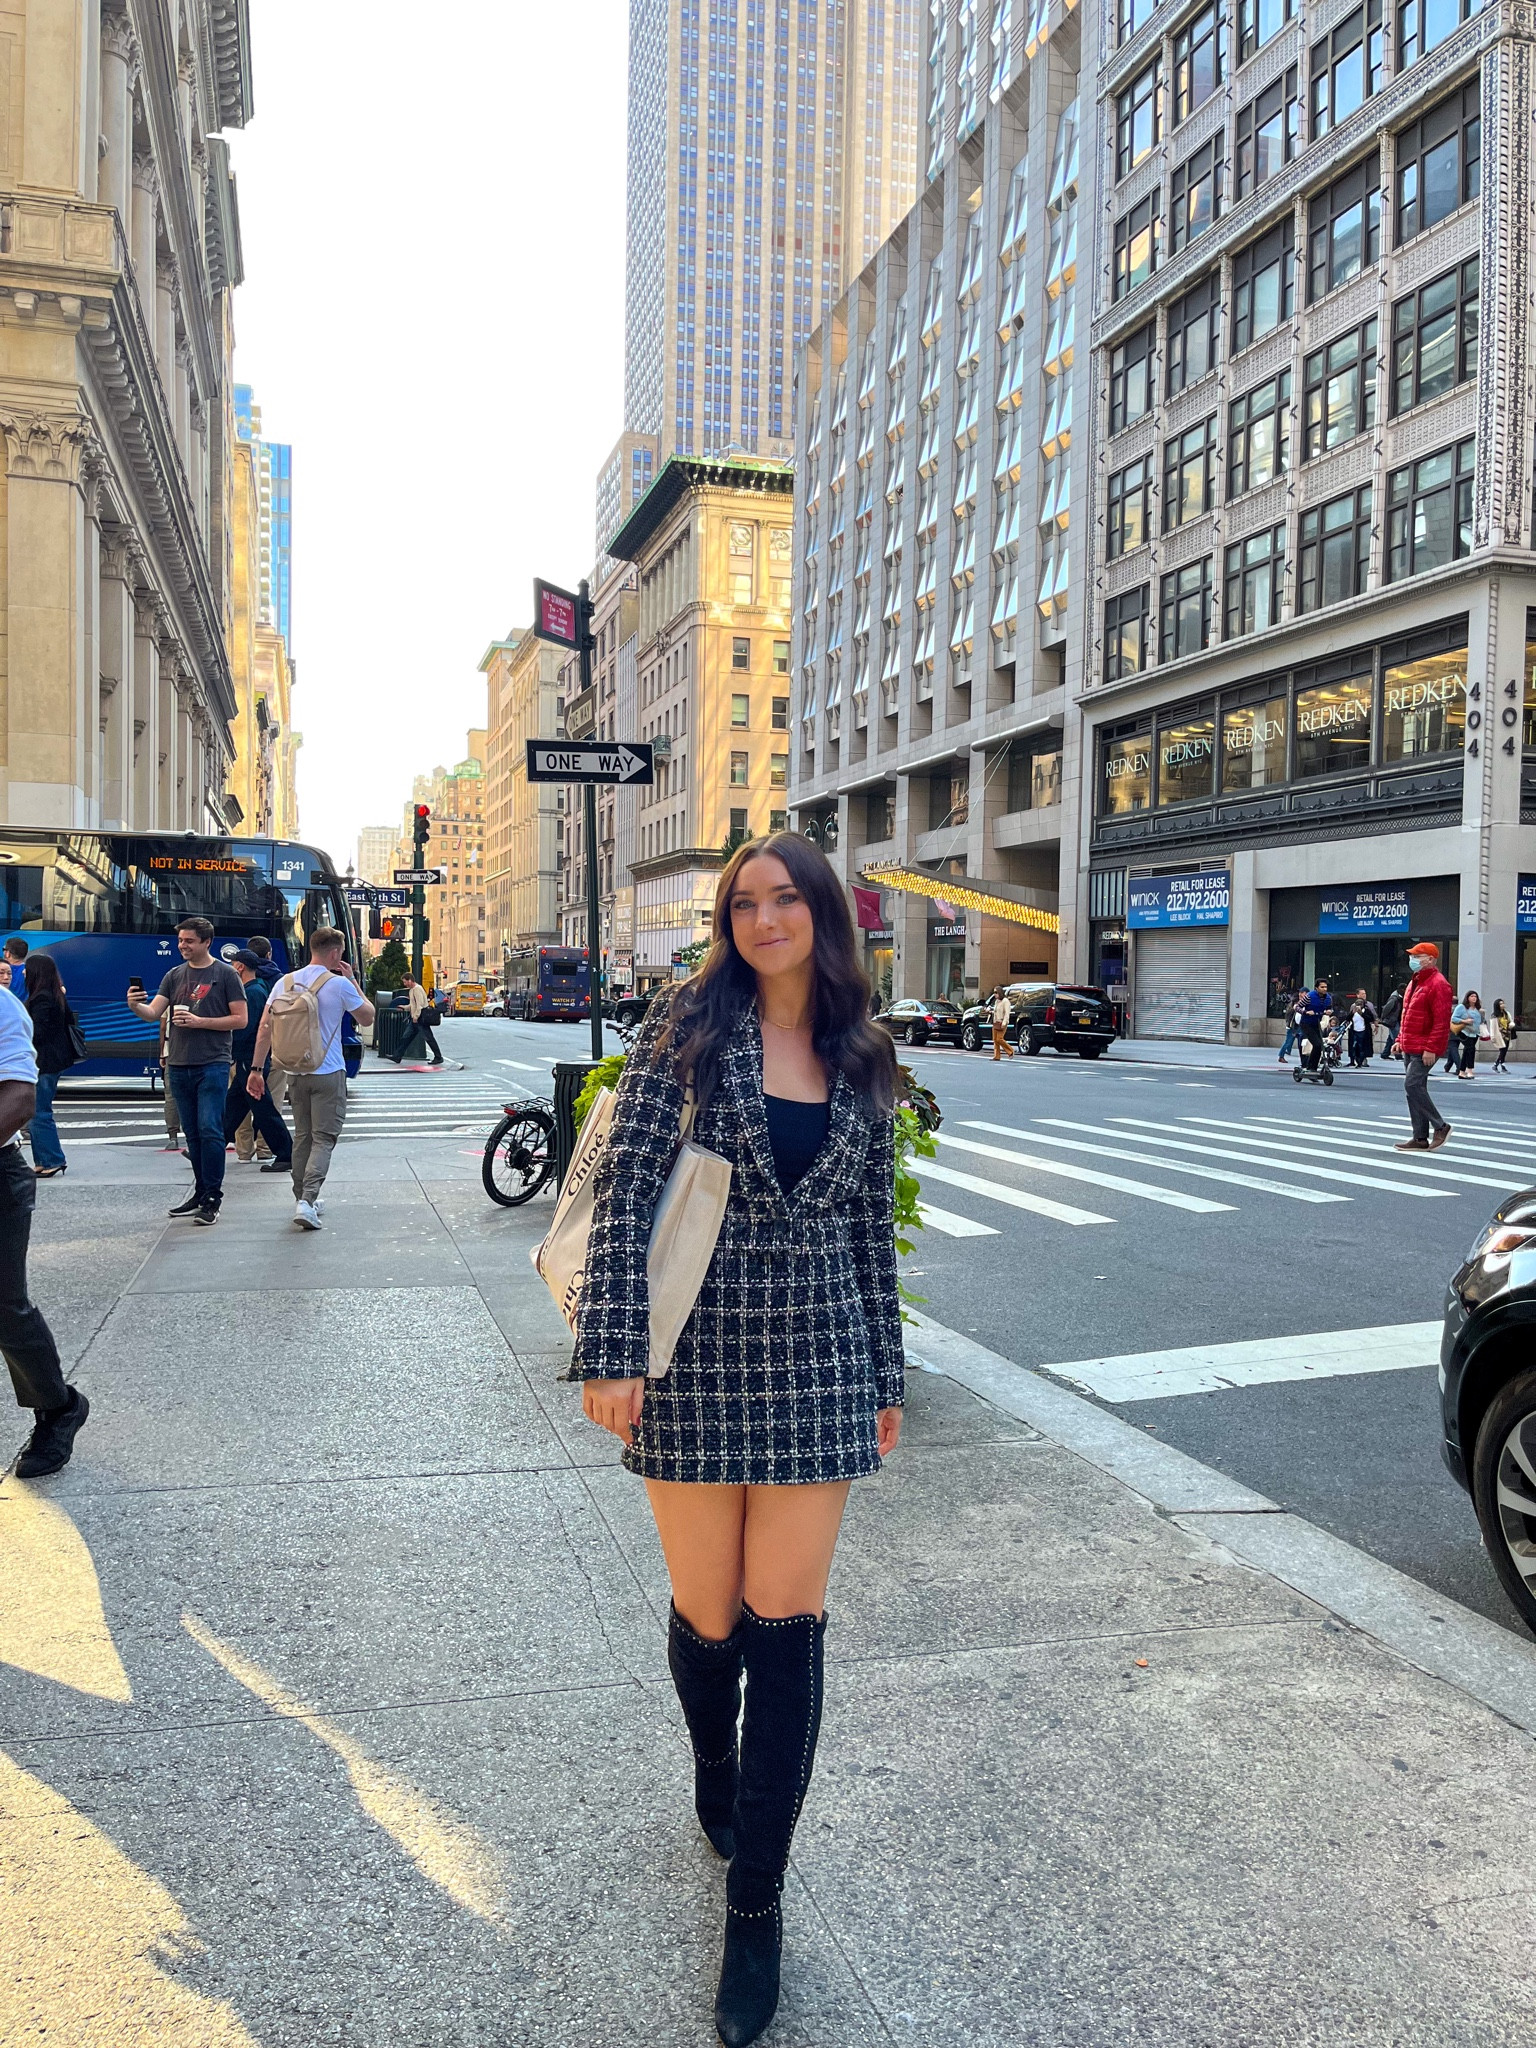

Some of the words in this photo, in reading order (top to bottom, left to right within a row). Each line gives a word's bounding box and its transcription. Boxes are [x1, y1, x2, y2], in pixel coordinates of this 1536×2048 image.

[551, 593, 571, 610] STANDING
[1388, 674, 1467, 712] REDKEN
[1300, 697, 1368, 733] REDKEN
[1226, 717, 1284, 750] REDKEN
[1322, 727, 1342, 736] AVENUE
[1161, 737, 1211, 765] REDKEN
[545, 753, 582, 771] ONE
[598, 755, 635, 772] WAY
[1105, 752, 1150, 778] REDKEN
[150, 857, 173, 869] NOT
[177, 858, 191, 869] IN
[194, 859, 248, 873] SERVICE
[282, 860, 305, 871] 1341
[1170, 879, 1190, 892] RETAIL
[1191, 879, 1204, 890] FOR
[1204, 877, 1226, 889] LEASE
[346, 891, 366, 901] East
[390, 893, 401, 902] St
[1166, 889, 1230, 912] 212.792.2600
[1356, 894, 1374, 903] RETAIL
[1374, 893, 1387, 902] FOR
[1386, 891, 1405, 901] LEASE
[1352, 904, 1408, 919] 212.792.2600
[934, 926, 945, 937] THE
[566, 1132, 606, 1198] Chloé
